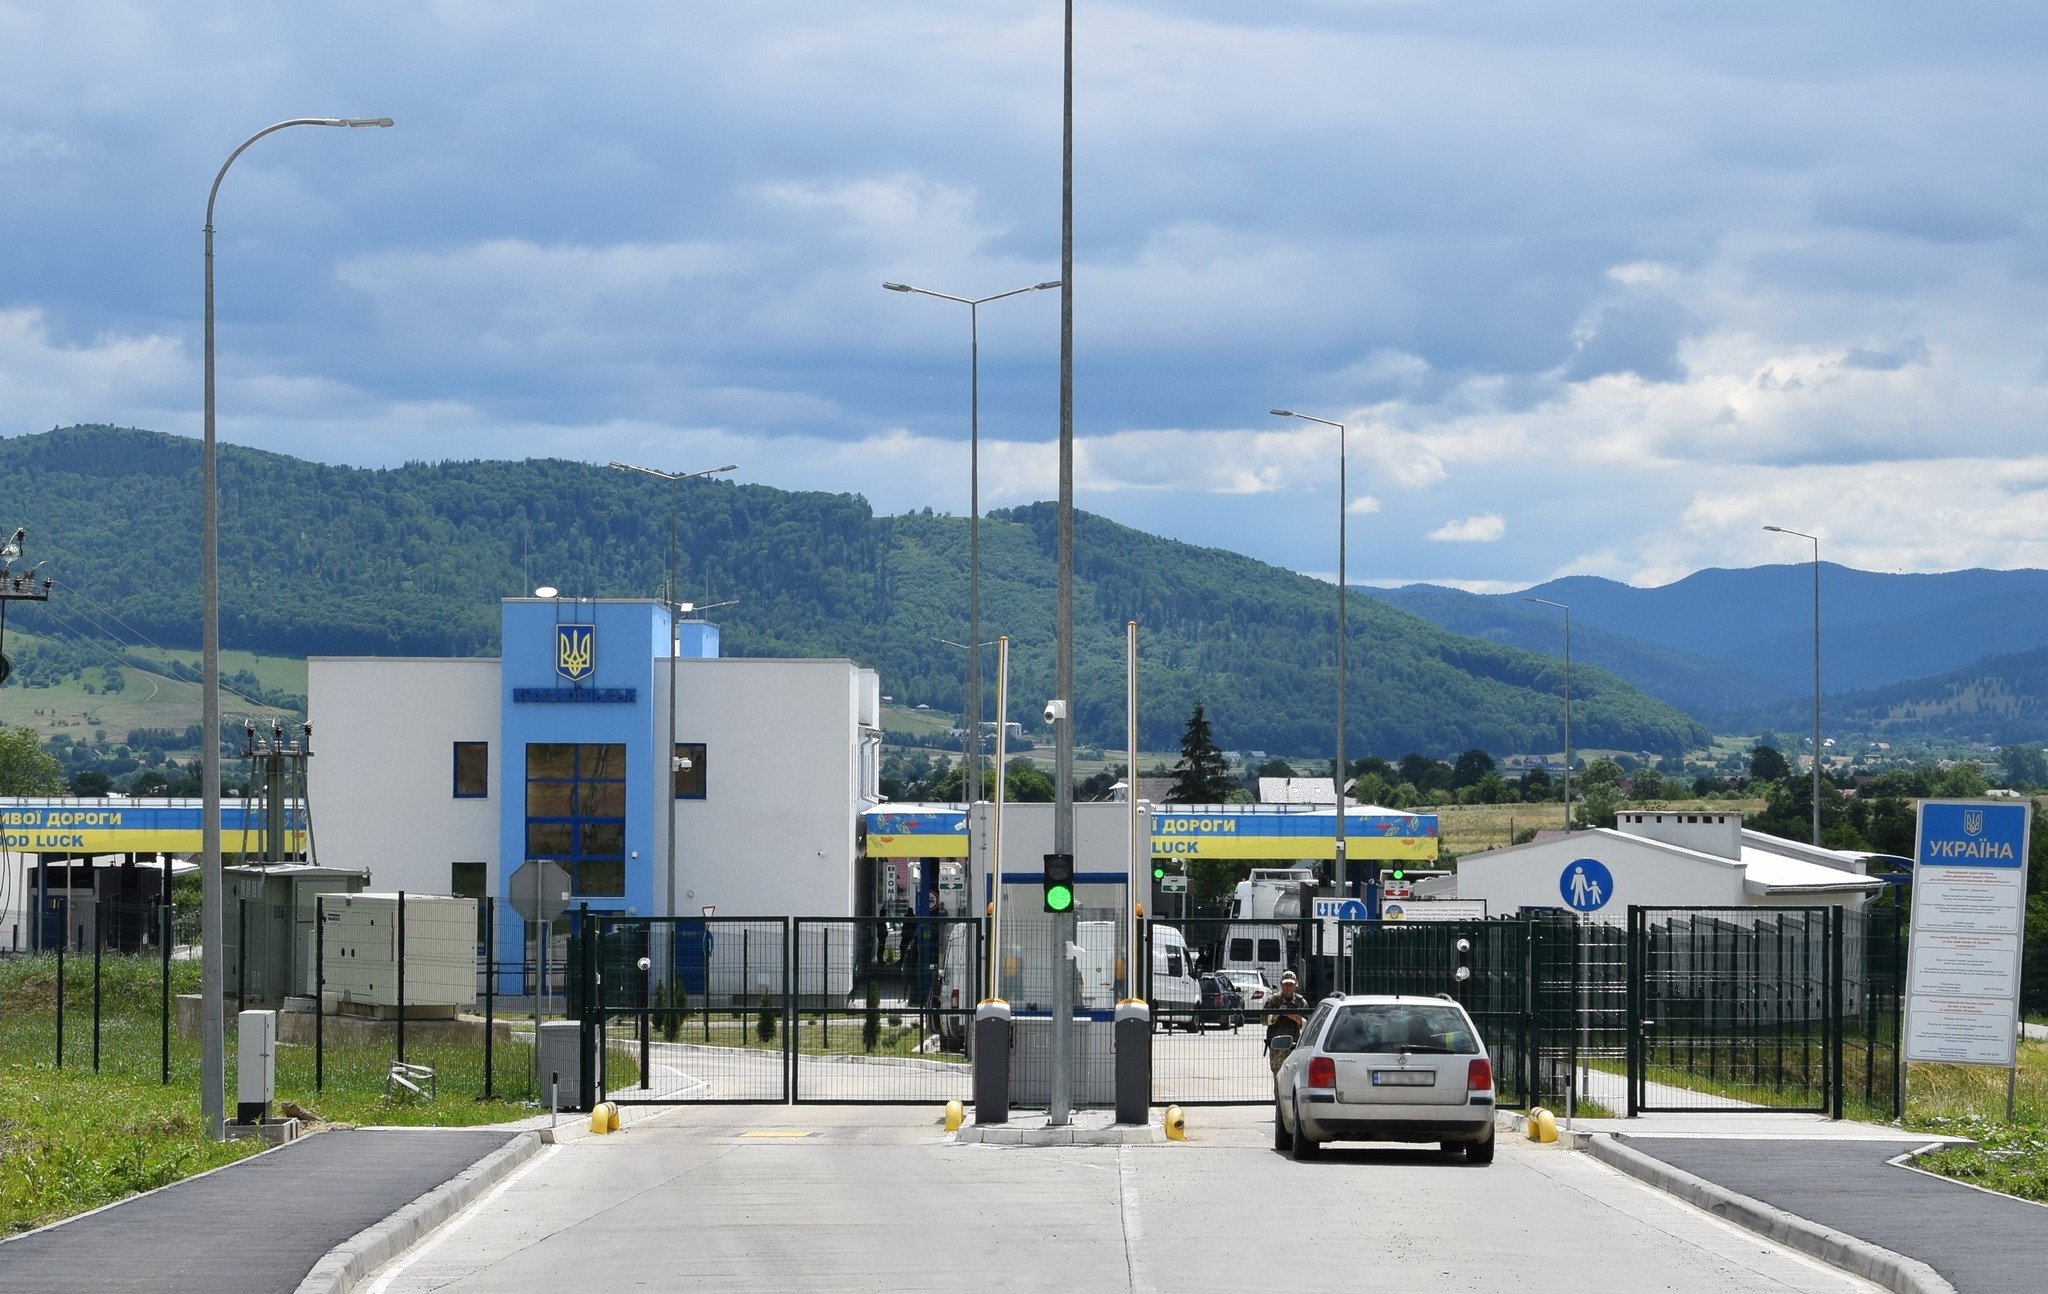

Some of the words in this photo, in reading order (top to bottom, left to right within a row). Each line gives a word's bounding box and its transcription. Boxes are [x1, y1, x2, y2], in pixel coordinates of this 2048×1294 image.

[47, 812, 122, 827] ДОРОГИ
[1162, 819, 1236, 834] ДОРОГИ
[36, 835, 84, 847] LUCK
[1151, 841, 1199, 854] LUCK
[1929, 838, 2014, 859] УКРАЇНА
